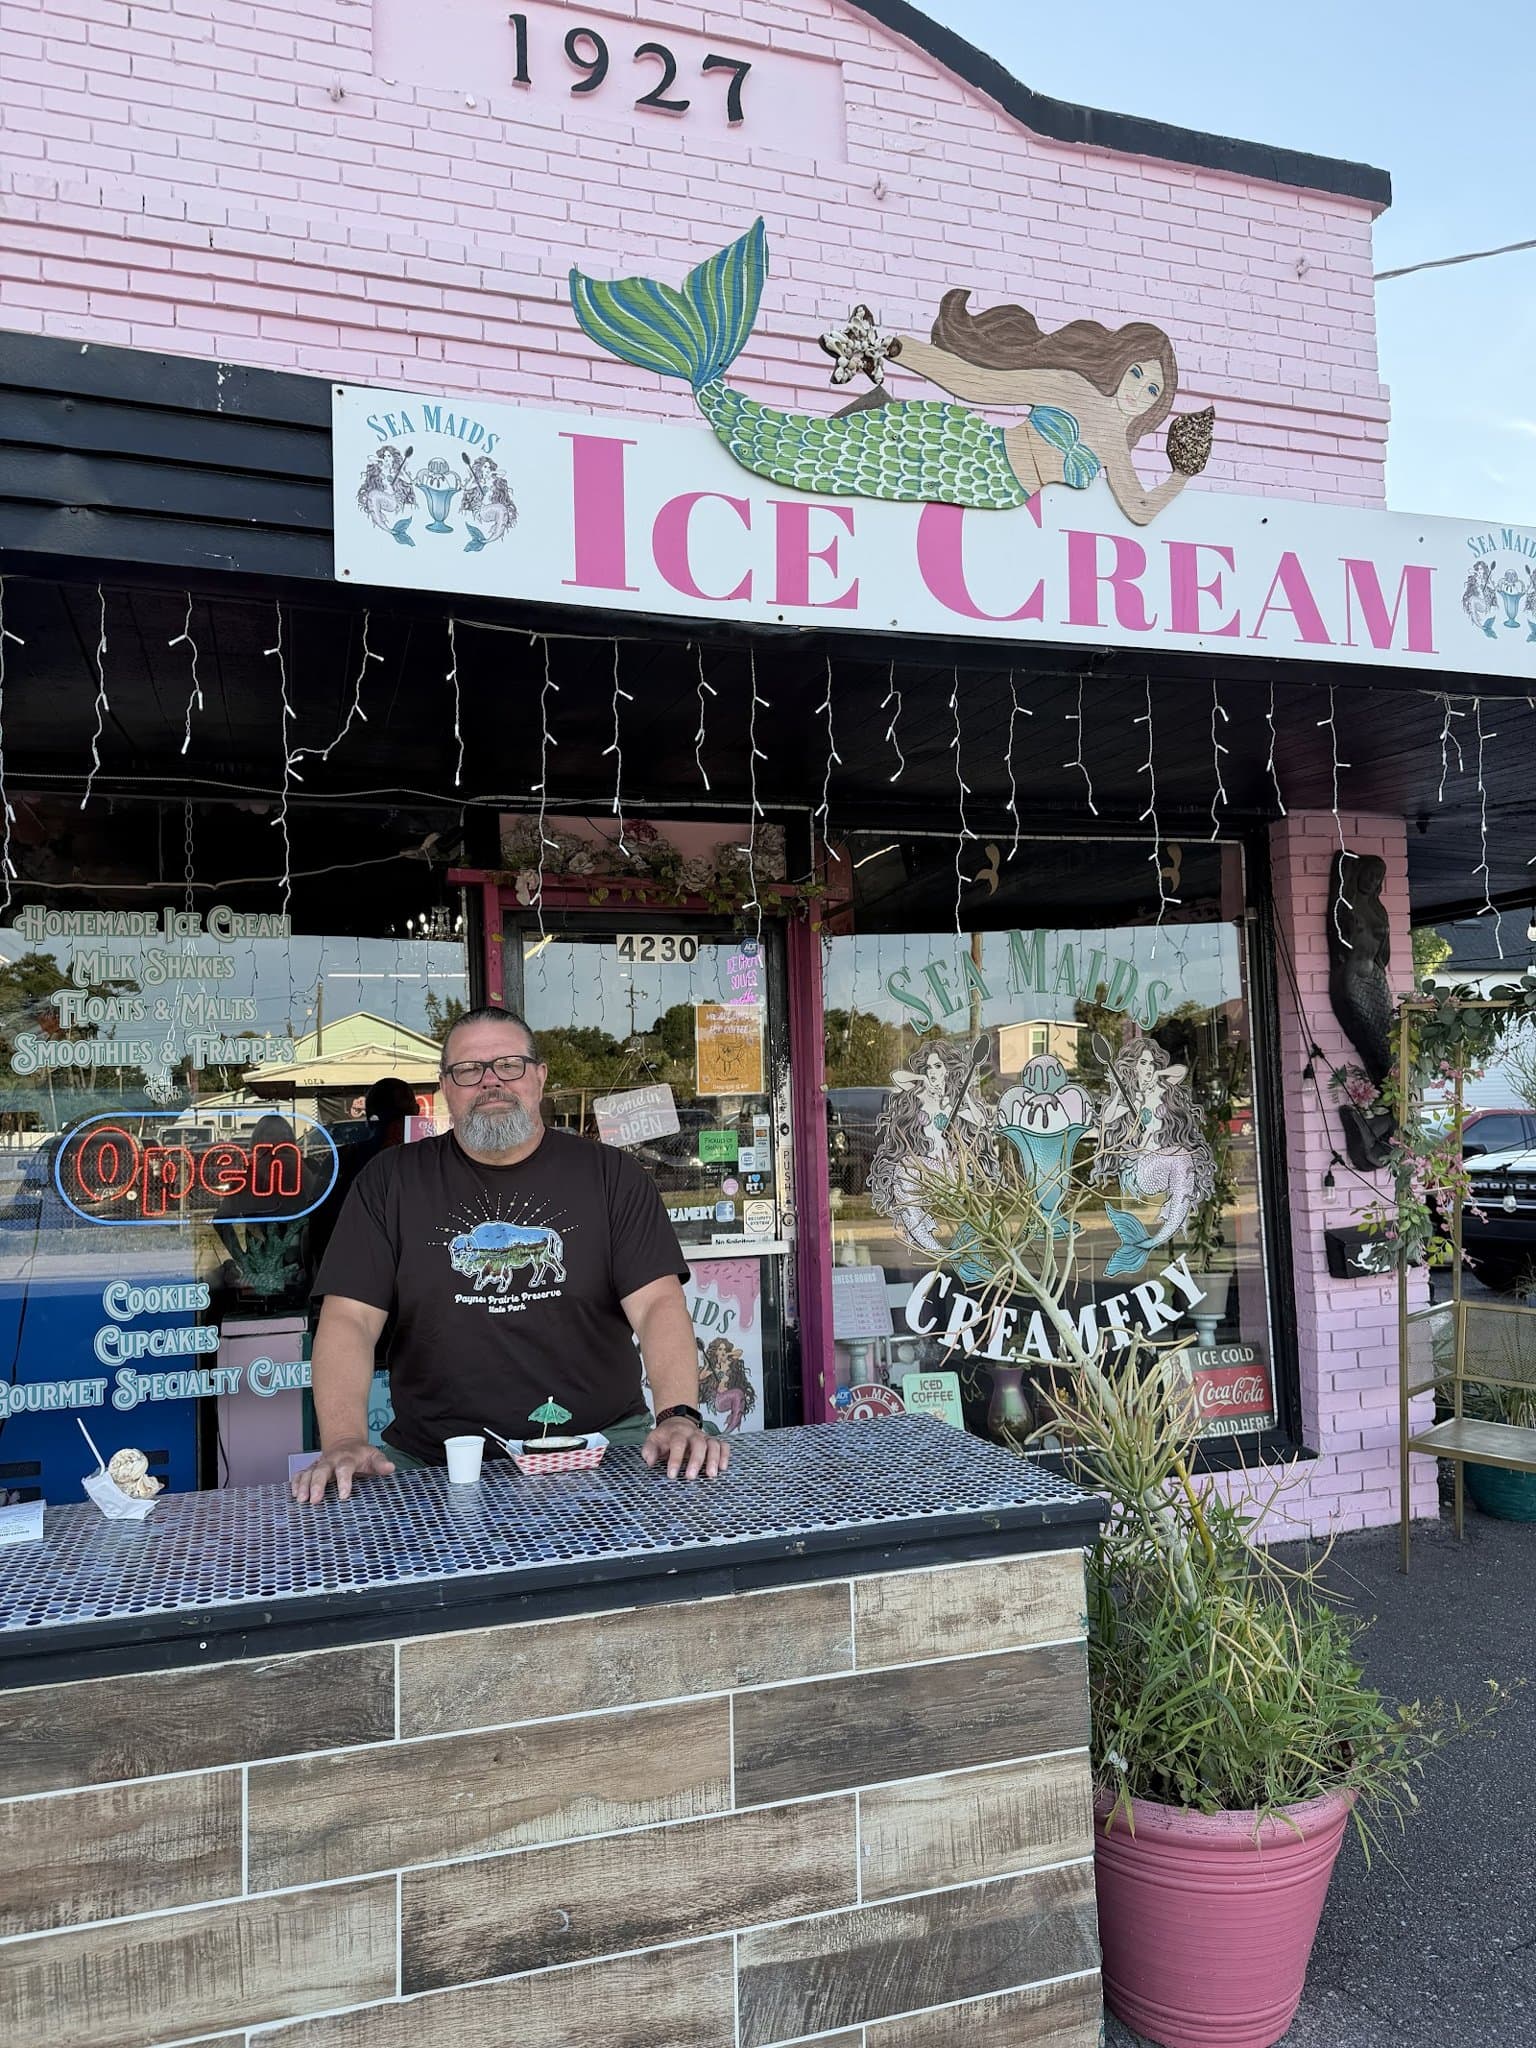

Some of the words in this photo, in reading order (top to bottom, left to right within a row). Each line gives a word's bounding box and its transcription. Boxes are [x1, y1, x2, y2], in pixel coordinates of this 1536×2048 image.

[508, 14, 752, 127] 1927
[366, 410, 416, 442] SEA
[422, 404, 501, 454] MAIDS
[558, 432, 860, 611] ICE
[917, 491, 1439, 655] CREAM
[1467, 533, 1497, 558] SEA
[1500, 528, 1536, 559] MAID
[14, 905, 158, 941] HOMEMADE
[163, 907, 202, 943] ICE
[207, 905, 292, 943] CREAM
[73, 949, 137, 987] MILK
[143, 948, 236, 986] SHAKES
[619, 937, 696, 962] 4230
[886, 950, 993, 1036] SEA
[1005, 928, 1173, 1031] MAIDS
[52, 989, 147, 1028] FLOATS
[154, 996, 172, 1021] &
[181, 993, 257, 1028] MALTS
[11, 1033, 153, 1075] SMOOTHIES
[160, 1040, 181, 1066] &
[185, 1031, 296, 1070] FRAPPE'S
[621, 1114, 662, 1140] OPEN
[77, 1126, 302, 1216] Open
[783, 1151, 791, 1191] PUSH
[520, 1289, 562, 1301] Preserve
[787, 1256, 795, 1297] PUSH
[103, 1280, 211, 1321] COOKIES
[507, 1303, 527, 1312] Park
[691, 1297, 736, 1334] IDS
[905, 1253, 1208, 1363] CREAMERY
[94, 1325, 220, 1366] CUPCAKES
[1197, 1351, 1218, 1366] ICE
[1221, 1347, 1254, 1364] COLD
[112, 1368, 243, 1411] SPECIALTY
[247, 1357, 312, 1397] CAKE
[911, 1391, 954, 1403] COFFEE
[919, 1379, 943, 1391] ICED
[1209, 1418, 1239, 1434] SOLD
[1241, 1415, 1270, 1431] HERE
